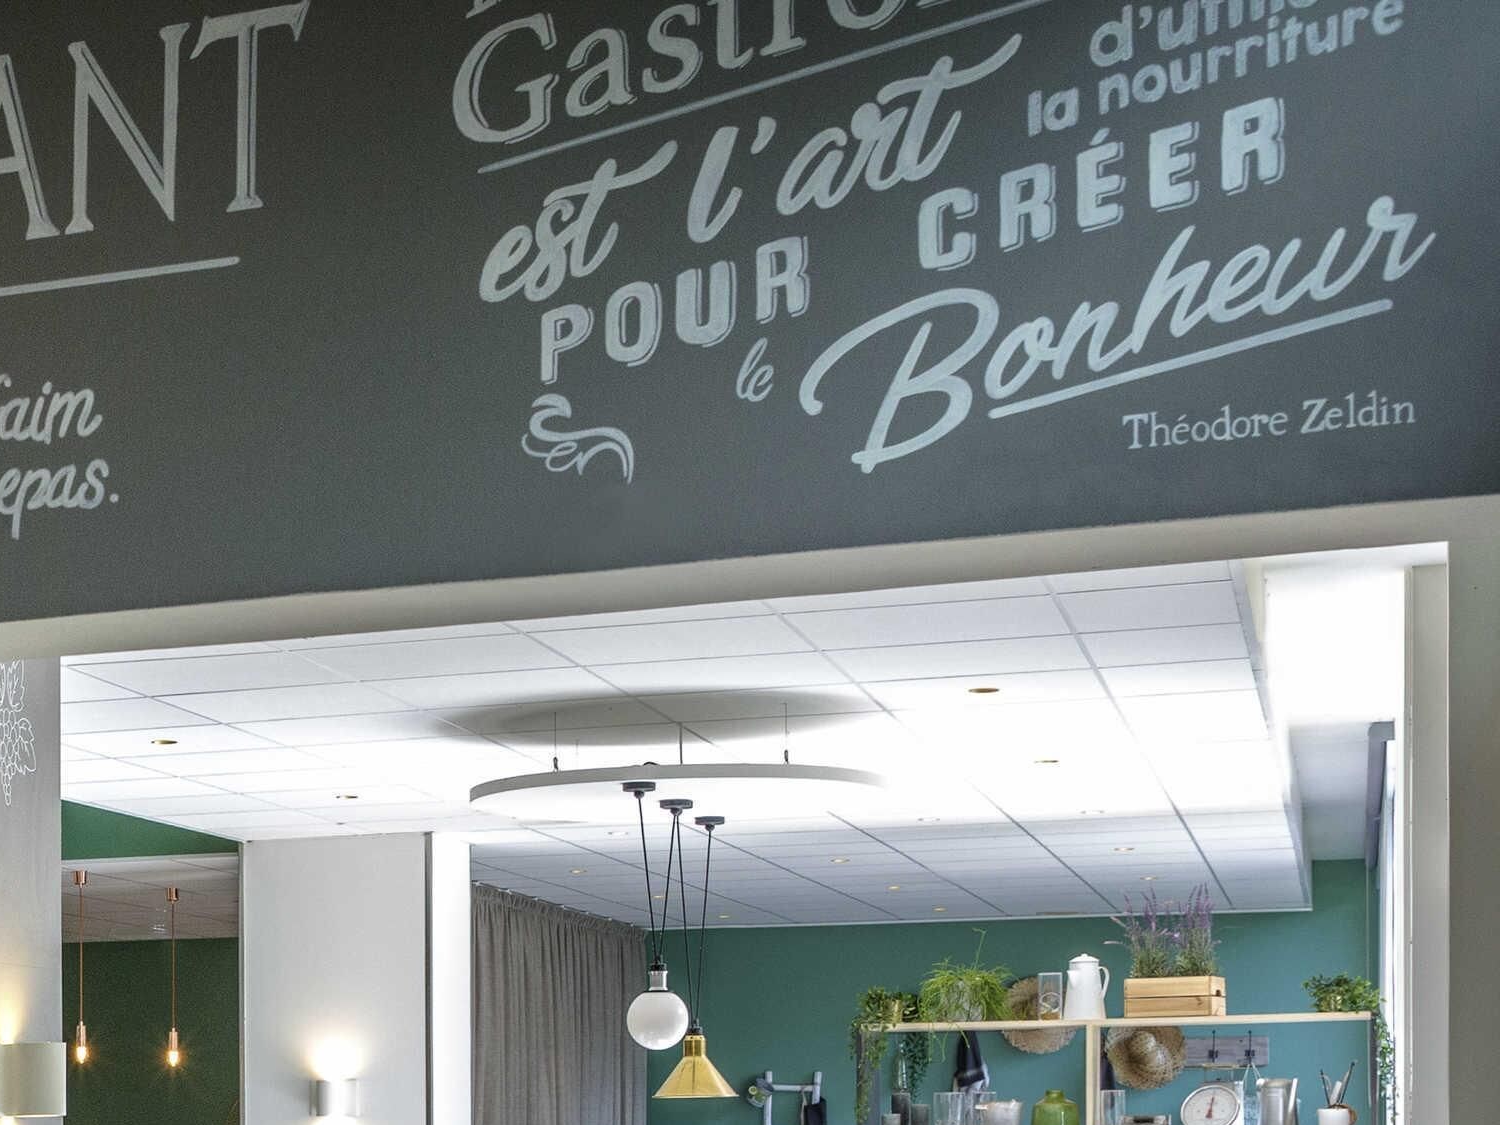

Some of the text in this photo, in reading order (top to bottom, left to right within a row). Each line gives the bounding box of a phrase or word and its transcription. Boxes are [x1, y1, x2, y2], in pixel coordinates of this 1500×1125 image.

[479, 33, 1022, 302] est l'art
[1027, 0, 1402, 137] la nourriture
[541, 97, 1286, 385] POUR CRÉER
[736, 196, 1435, 473] le Bonheur
[1122, 390, 1415, 449] Théodore Zeldin
